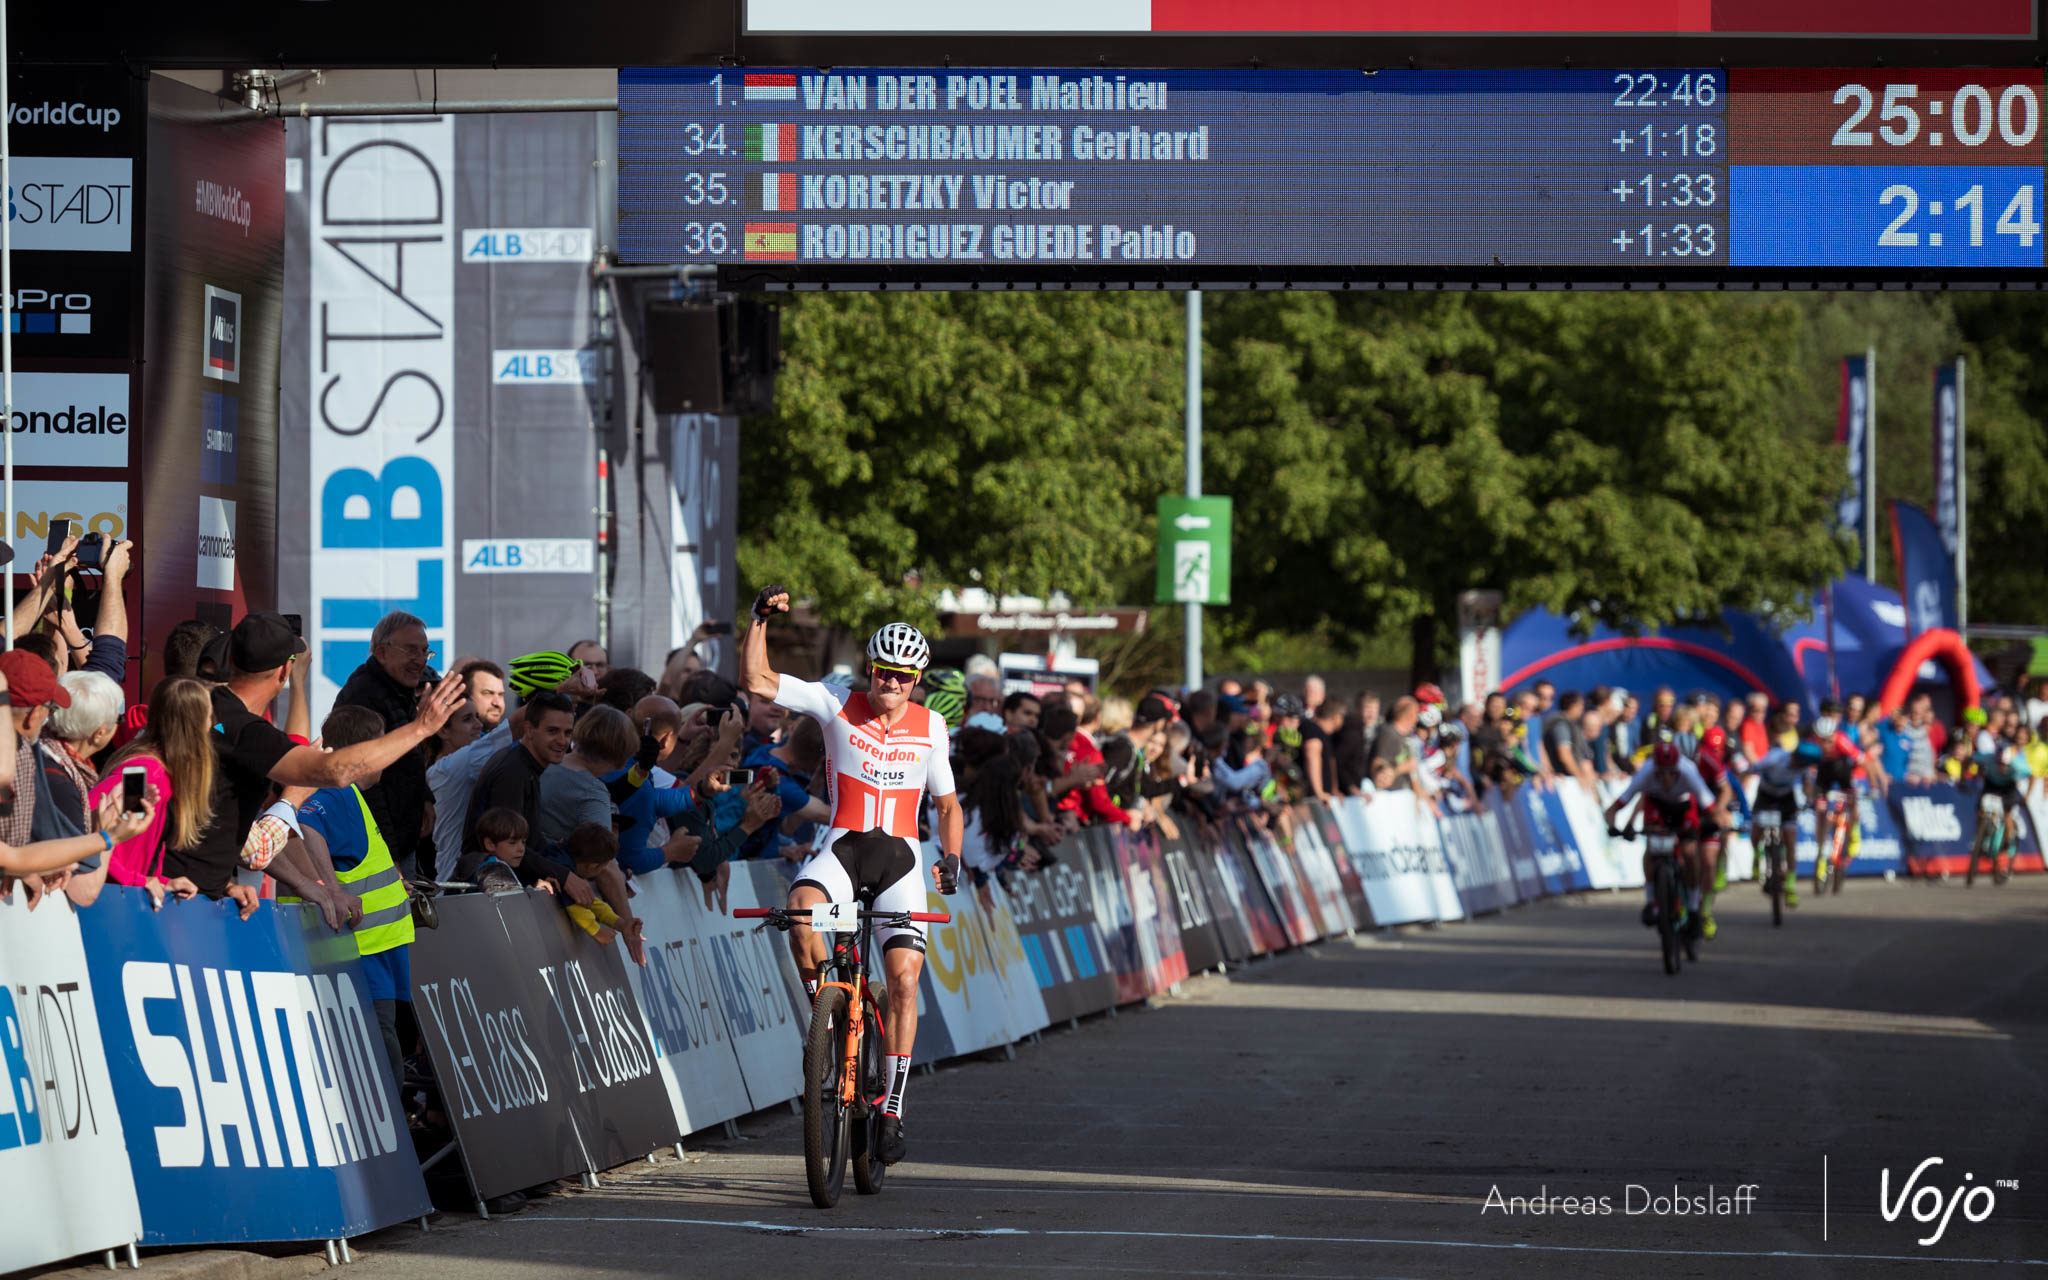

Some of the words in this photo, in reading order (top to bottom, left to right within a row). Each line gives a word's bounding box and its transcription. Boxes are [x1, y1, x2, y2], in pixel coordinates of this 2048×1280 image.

[709, 73, 738, 106] 1.
[802, 76, 867, 110] VAN
[878, 76, 937, 110] DER
[947, 76, 1022, 110] POEL
[1031, 74, 1168, 110] Mathieu
[1613, 73, 1716, 107] 22:46
[1831, 84, 2038, 146] 25:00
[684, 123, 738, 155] 34.
[802, 126, 1062, 159] KERSCHBAUMER
[1072, 125, 1209, 160] Gerhard
[1612, 124, 1716, 156] +1:18
[684, 173, 738, 206] 35.
[802, 175, 963, 208] KORETZKY
[972, 174, 1074, 208] Victor
[1612, 174, 1716, 206] +1:33
[1877, 184, 2041, 247] 2:14
[684, 222, 738, 255] 36.
[802, 225, 984, 259] RODRIGUEZ
[992, 225, 1094, 259] GUEDE
[1101, 225, 1196, 259] Pablo
[1612, 224, 1716, 256] +1:33
[0, 288, 92, 310] Pro
[0, 405, 127, 434] ondale
[829, 904, 840, 919] 4
[538, 960, 651, 1093] X-Class
[122, 961, 398, 1168] SHIMANO
[420, 977, 549, 1120] X-Class
